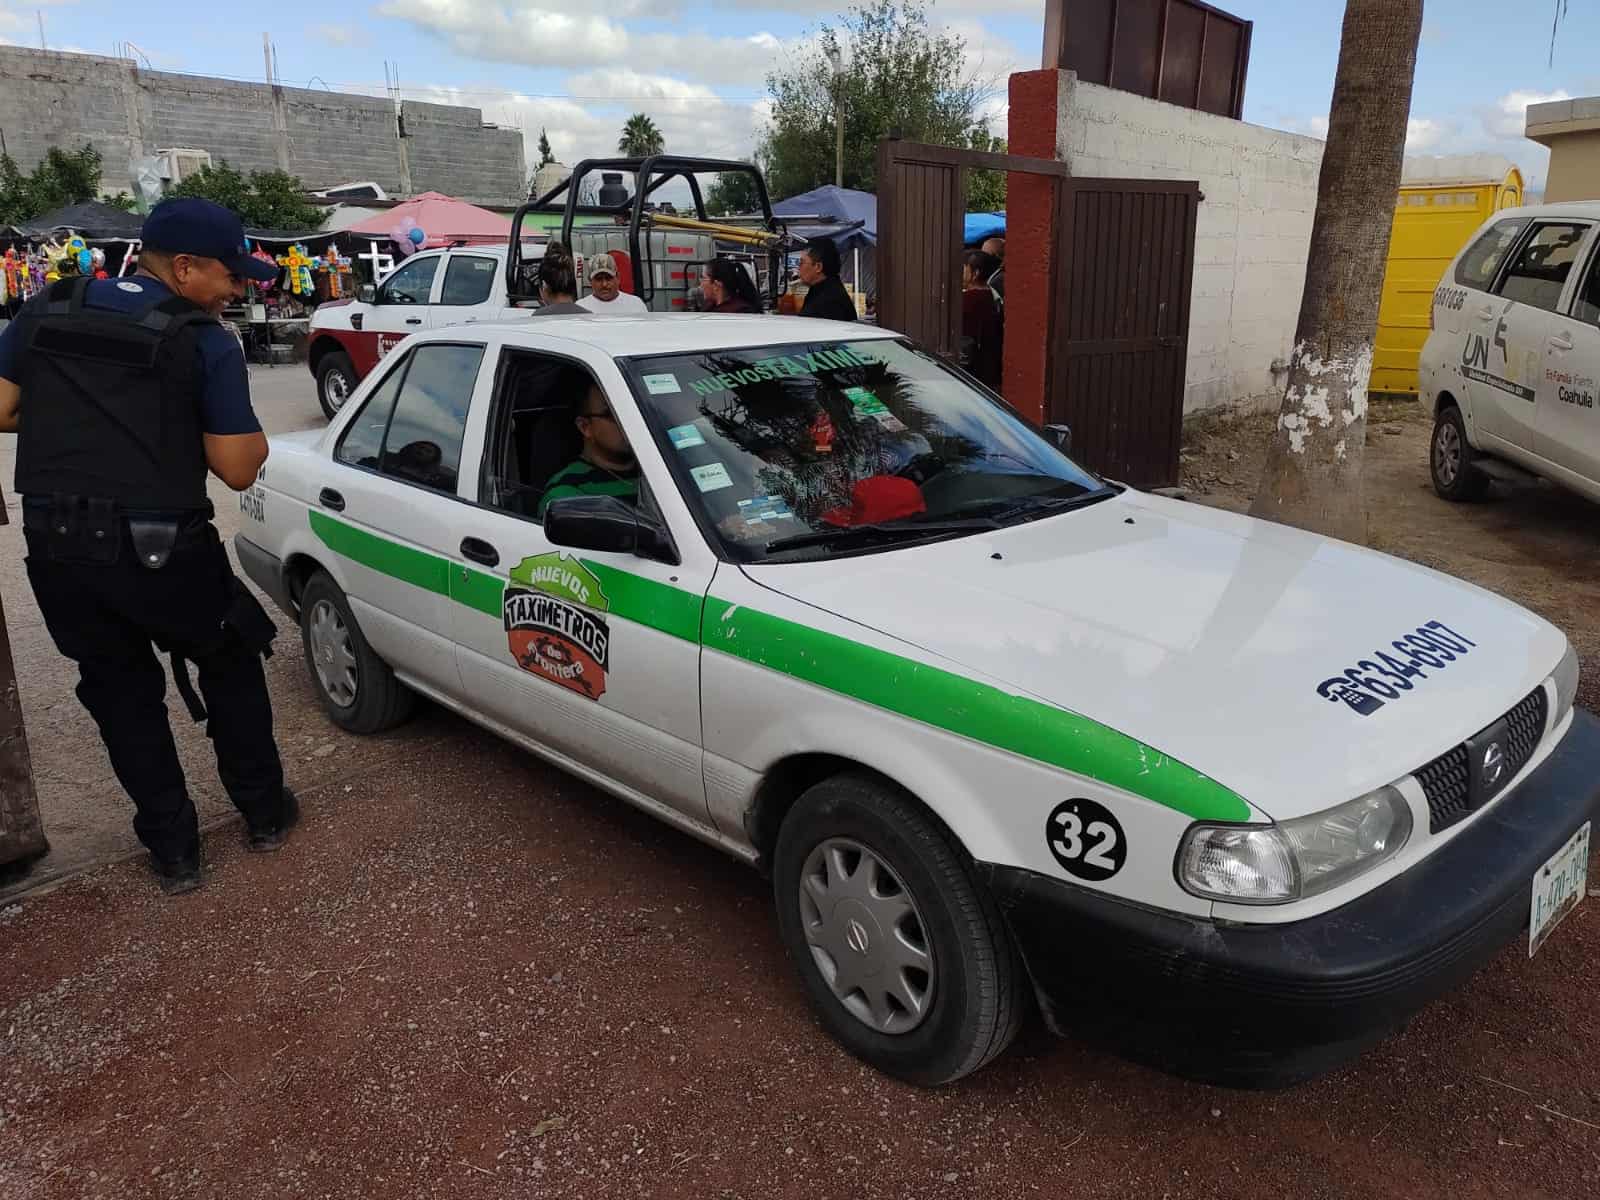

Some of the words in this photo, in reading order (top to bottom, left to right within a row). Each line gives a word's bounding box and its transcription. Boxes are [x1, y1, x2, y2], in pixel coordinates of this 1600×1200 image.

[688, 364, 777, 396] NUEVOS
[1558, 386, 1593, 409] Coahuila
[531, 566, 589, 603] NUEVOS
[527, 641, 584, 679] Frontera
[1344, 620, 1477, 699] 634-6907
[1053, 811, 1117, 871] 32
